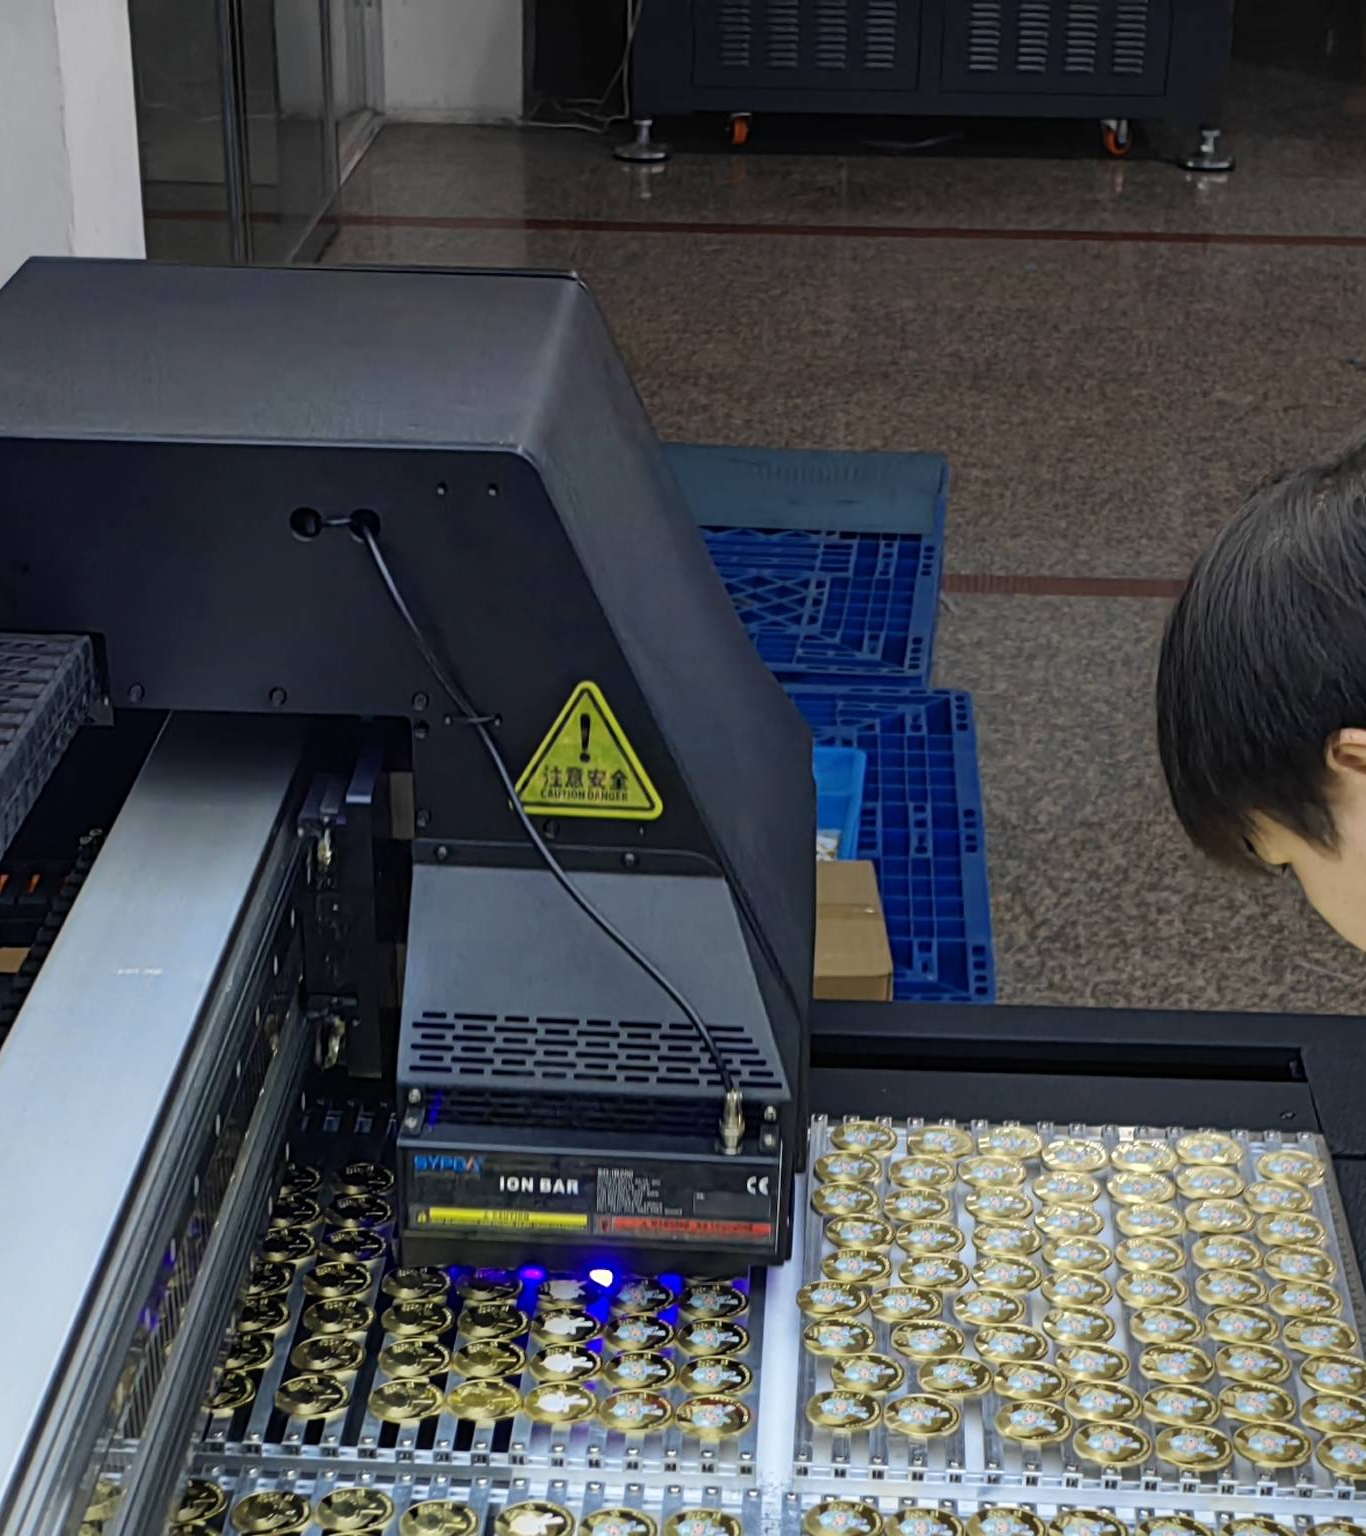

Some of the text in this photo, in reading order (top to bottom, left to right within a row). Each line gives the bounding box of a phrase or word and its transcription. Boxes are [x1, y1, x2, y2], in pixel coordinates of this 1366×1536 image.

[541, 765, 628, 790] 注意安全
[540, 787, 628, 801] CAUTION DANGER
[499, 1176, 579, 1196] ION BAR
[746, 1176, 769, 1196] CE
